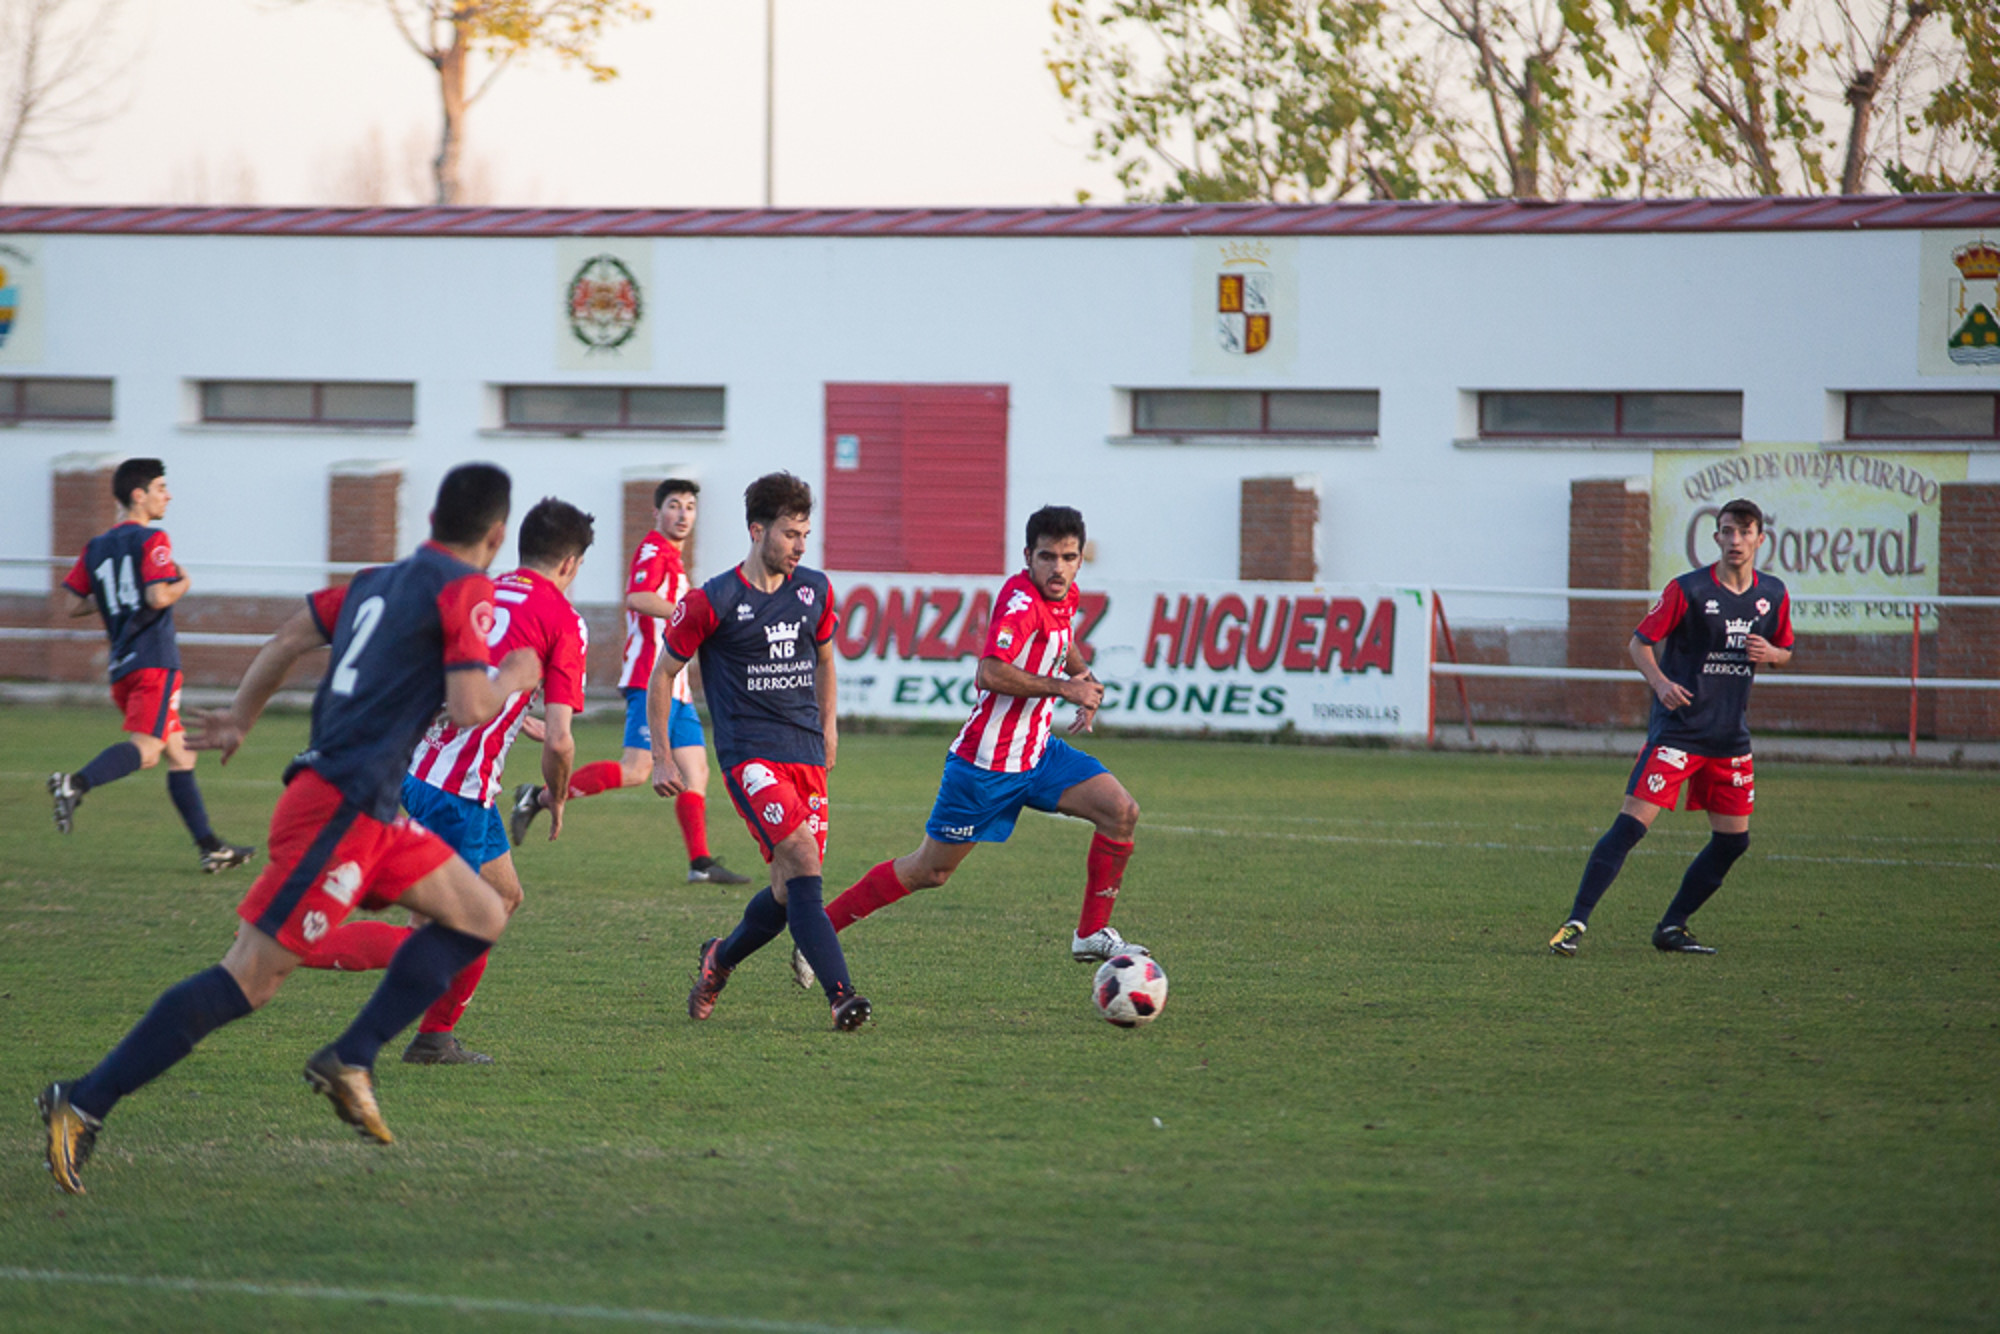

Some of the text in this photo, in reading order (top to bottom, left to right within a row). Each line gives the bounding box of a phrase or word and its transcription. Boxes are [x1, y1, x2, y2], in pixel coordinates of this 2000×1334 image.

[1684, 451, 1938, 505] QUESO DE OVEJA CURADO
[95, 554, 141, 616] 14
[331, 596, 386, 696] 2
[769, 641, 795, 659] NB
[834, 583, 1110, 668] ONZAZ
[1143, 594, 1397, 675] HIGUERA
